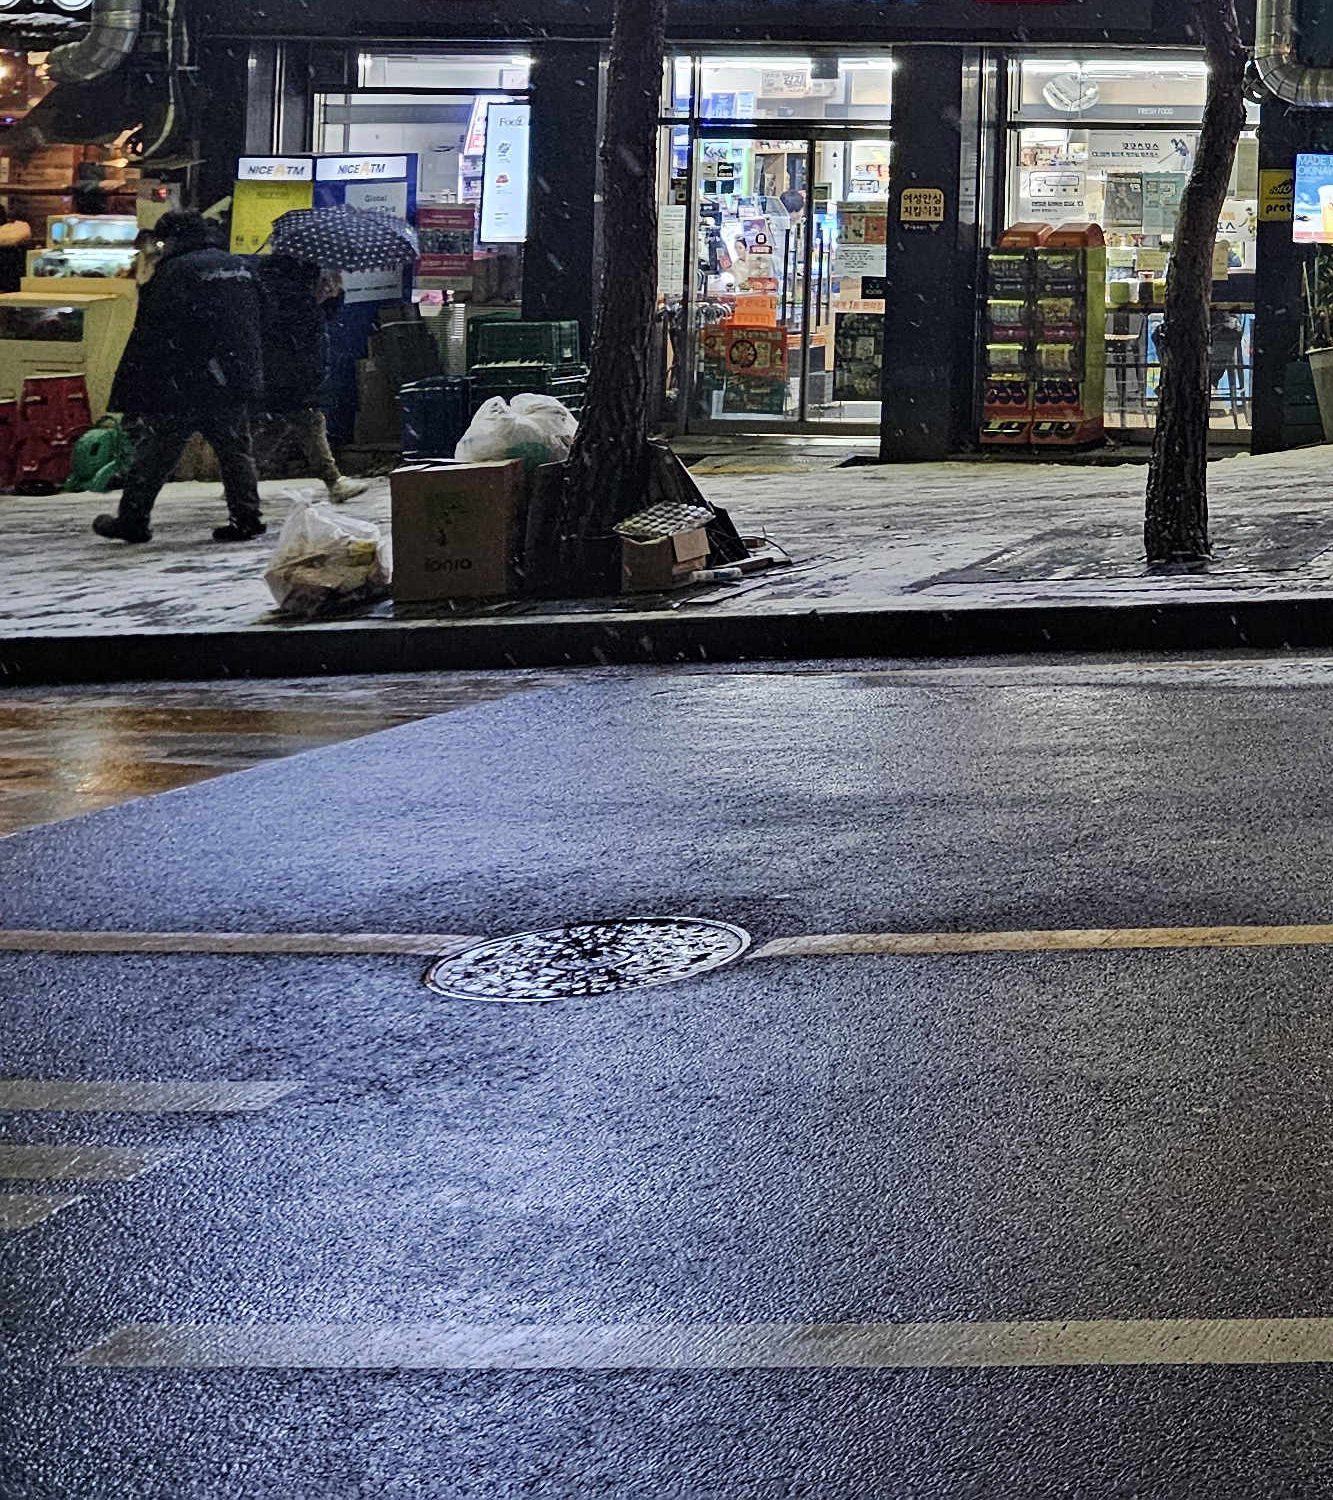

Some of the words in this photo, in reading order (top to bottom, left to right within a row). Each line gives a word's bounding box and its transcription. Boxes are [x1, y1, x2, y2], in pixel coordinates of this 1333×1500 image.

[1298, 156, 1327, 165] MADE
[247, 166, 273, 175] NICE
[273, 164, 305, 176] ATM
[337, 165, 360, 174] NICE
[360, 162, 386, 175] ATM
[903, 194, 942, 205] 여성안심
[903, 206, 942, 217] 지킴이집
[1266, 203, 1291, 213] prot
